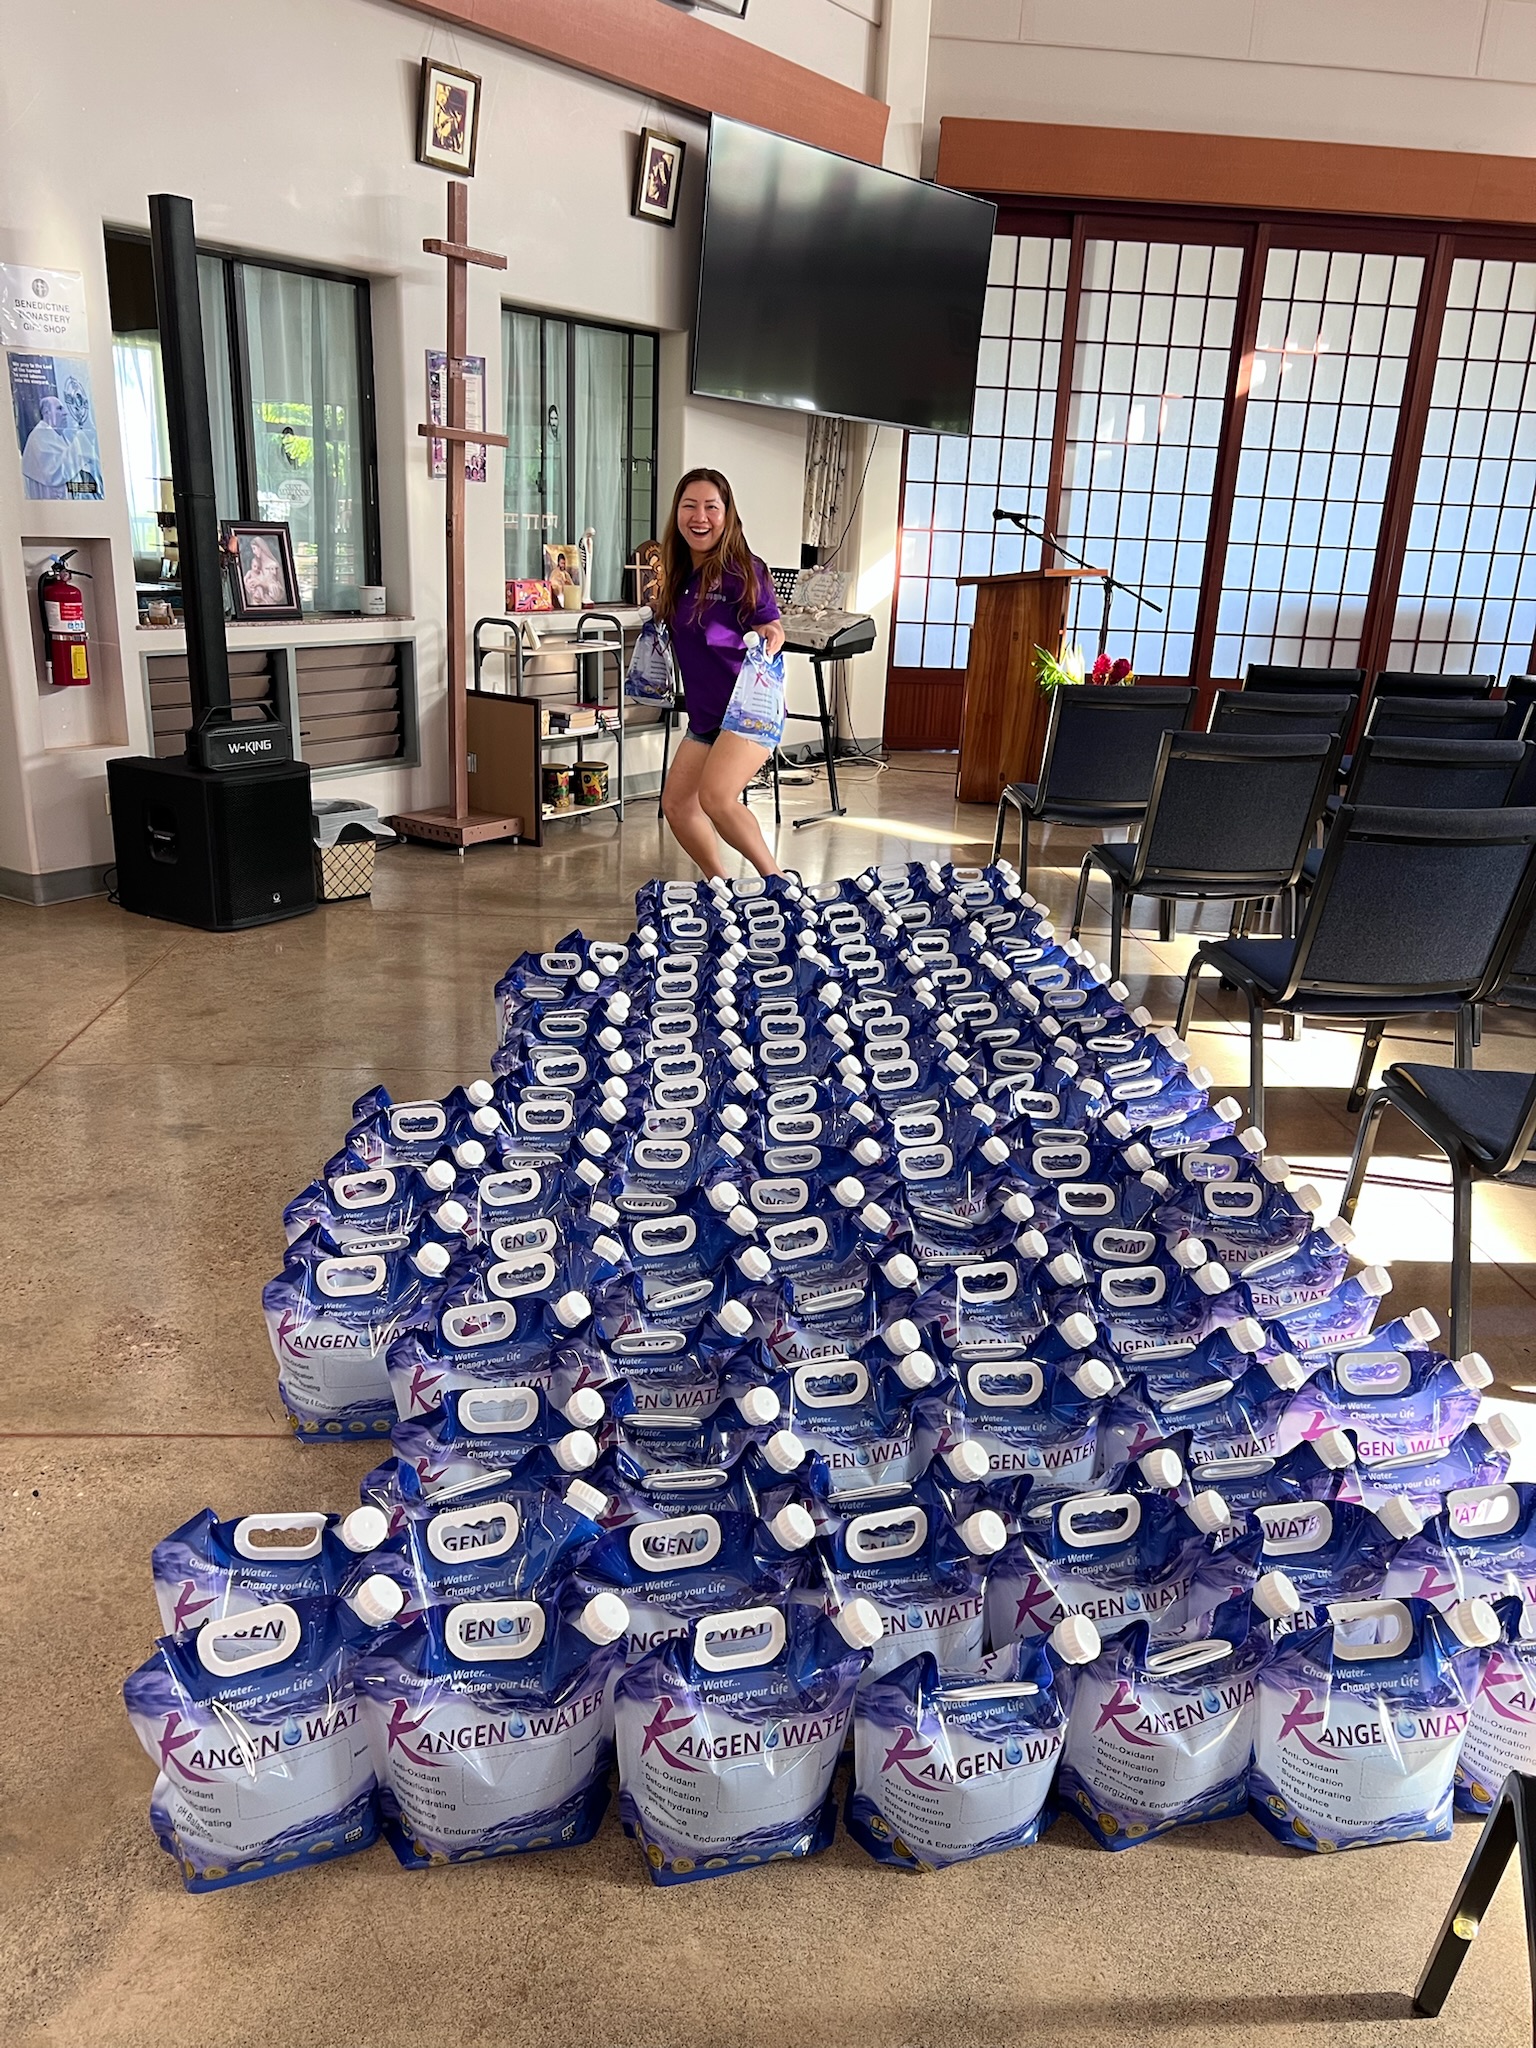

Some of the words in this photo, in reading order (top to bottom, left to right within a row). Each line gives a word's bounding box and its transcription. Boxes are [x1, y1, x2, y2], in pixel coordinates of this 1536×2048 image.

[15, 299, 70, 313] BENEDICTINE
[44, 324, 66, 334] SHOP
[228, 740, 272, 755] W-KING
[323, 1310, 351, 1318] Change
[353, 1309, 371, 1318] your
[372, 1306, 386, 1315] Life
[276, 1308, 358, 1359] KANGEN
[805, 1322, 832, 1330] Change
[456, 1360, 486, 1371] Change
[487, 1356, 505, 1367] your
[506, 1352, 521, 1363] Life
[619, 1366, 648, 1376] Change
[649, 1365, 667, 1375] your
[668, 1363, 684, 1373] Life
[1175, 1369, 1189, 1379] Life
[1350, 1410, 1380, 1420] Change
[1380, 1410, 1398, 1421] your
[1399, 1405, 1416, 1419] Life
[811, 1424, 840, 1434] Change
[841, 1423, 858, 1433] your
[859, 1418, 874, 1428] Life
[983, 1424, 1012, 1433] Change
[1013, 1424, 1031, 1434] your
[1032, 1421, 1047, 1432] Life
[1196, 1419, 1214, 1431] your
[467, 1450, 498, 1460] Change
[500, 1448, 520, 1459] your
[635, 1438, 665, 1448] Change
[666, 1439, 687, 1450] your
[1043, 1439, 1096, 1469] WATER
[1231, 1491, 1250, 1502] your
[1251, 1486, 1267, 1498] Life
[1373, 1481, 1402, 1490] Change
[1403, 1480, 1422, 1491] your
[1424, 1474, 1441, 1487] Life
[653, 1501, 688, 1512] Change
[690, 1503, 707, 1513] your
[709, 1500, 726, 1511] Life
[189, 1557, 220, 1574] Change
[1070, 1563, 1103, 1576] Change
[1104, 1561, 1126, 1575] your
[1462, 1555, 1492, 1569] Change
[1492, 1553, 1509, 1566] your
[240, 1578, 278, 1592] Change
[303, 1577, 321, 1592] Life
[445, 1584, 482, 1598] Change
[483, 1580, 506, 1593] your
[621, 1584, 643, 1596] your
[646, 1592, 682, 1604] Change
[684, 1588, 707, 1601] your
[708, 1581, 726, 1595] Life
[855, 1578, 888, 1592] Change
[1141, 1576, 1190, 1611] WATE
[925, 1596, 984, 1628] WATE
[453, 1668, 492, 1682] Water...
[494, 1678, 518, 1692] your
[519, 1673, 540, 1690] Life
[703, 1677, 741, 1692] Water...
[1336, 1668, 1372, 1681] Water...
[1340, 1679, 1375, 1694] Change
[1376, 1678, 1399, 1693] your
[1400, 1671, 1420, 1689] Life
[219, 1684, 261, 1702] Water...
[265, 1685, 290, 1704] your
[292, 1677, 314, 1694] Life
[705, 1688, 745, 1705] Change
[745, 1687, 769, 1703] your
[770, 1681, 789, 1696] Life
[305, 1703, 363, 1742] WAT
[945, 1708, 983, 1727] Change
[983, 1705, 1006, 1721] your
[1006, 1697, 1025, 1714] Life
[1092, 1680, 1204, 1748] KANGEN
[386, 1697, 507, 1768] KANGEN
[529, 1690, 605, 1737] WATER
[639, 1695, 761, 1774] KANGEN
[1419, 1709, 1469, 1739] WAT
[1470, 1709, 1529, 1740] Anti-Oxidant
[1465, 1730, 1492, 1750] Super
[1468, 1720, 1533, 1752] Detoxification
[879, 1726, 1003, 1793] KANGEN
[1096, 1745, 1160, 1776] Detoxification
[1097, 1735, 1156, 1763] Anti-Oxidant
[1282, 1745, 1340, 1776] Anti-Oxidant
[1463, 1742, 1476, 1754] pH
[1477, 1748, 1516, 1772] Balance
[644, 1760, 698, 1790] Anti-Oxidant
[1096, 1756, 1122, 1776] Super
[1122, 1770, 1167, 1789] hydrating
[1280, 1755, 1344, 1789] Detoxification
[644, 1772, 702, 1804] Detoxification
[884, 1776, 941, 1807] Anti-Oxidant
[1092, 1776, 1139, 1810] Energizing
[1281, 1767, 1306, 1787] Super
[1306, 1780, 1352, 1804] hydrating
[1293, 1784, 1330, 1808] Balance
[415, 1791, 457, 1813] hydrating
[645, 1783, 667, 1803] Super
[667, 1797, 710, 1820] hydrating
[883, 1786, 945, 1818] Detoxification
[884, 1795, 908, 1816] Super
[908, 1807, 953, 1830] hydrating
[1280, 1788, 1325, 1820] Energizing
[883, 1812, 926, 1846] Energizing
[894, 1811, 931, 1836] Balance
